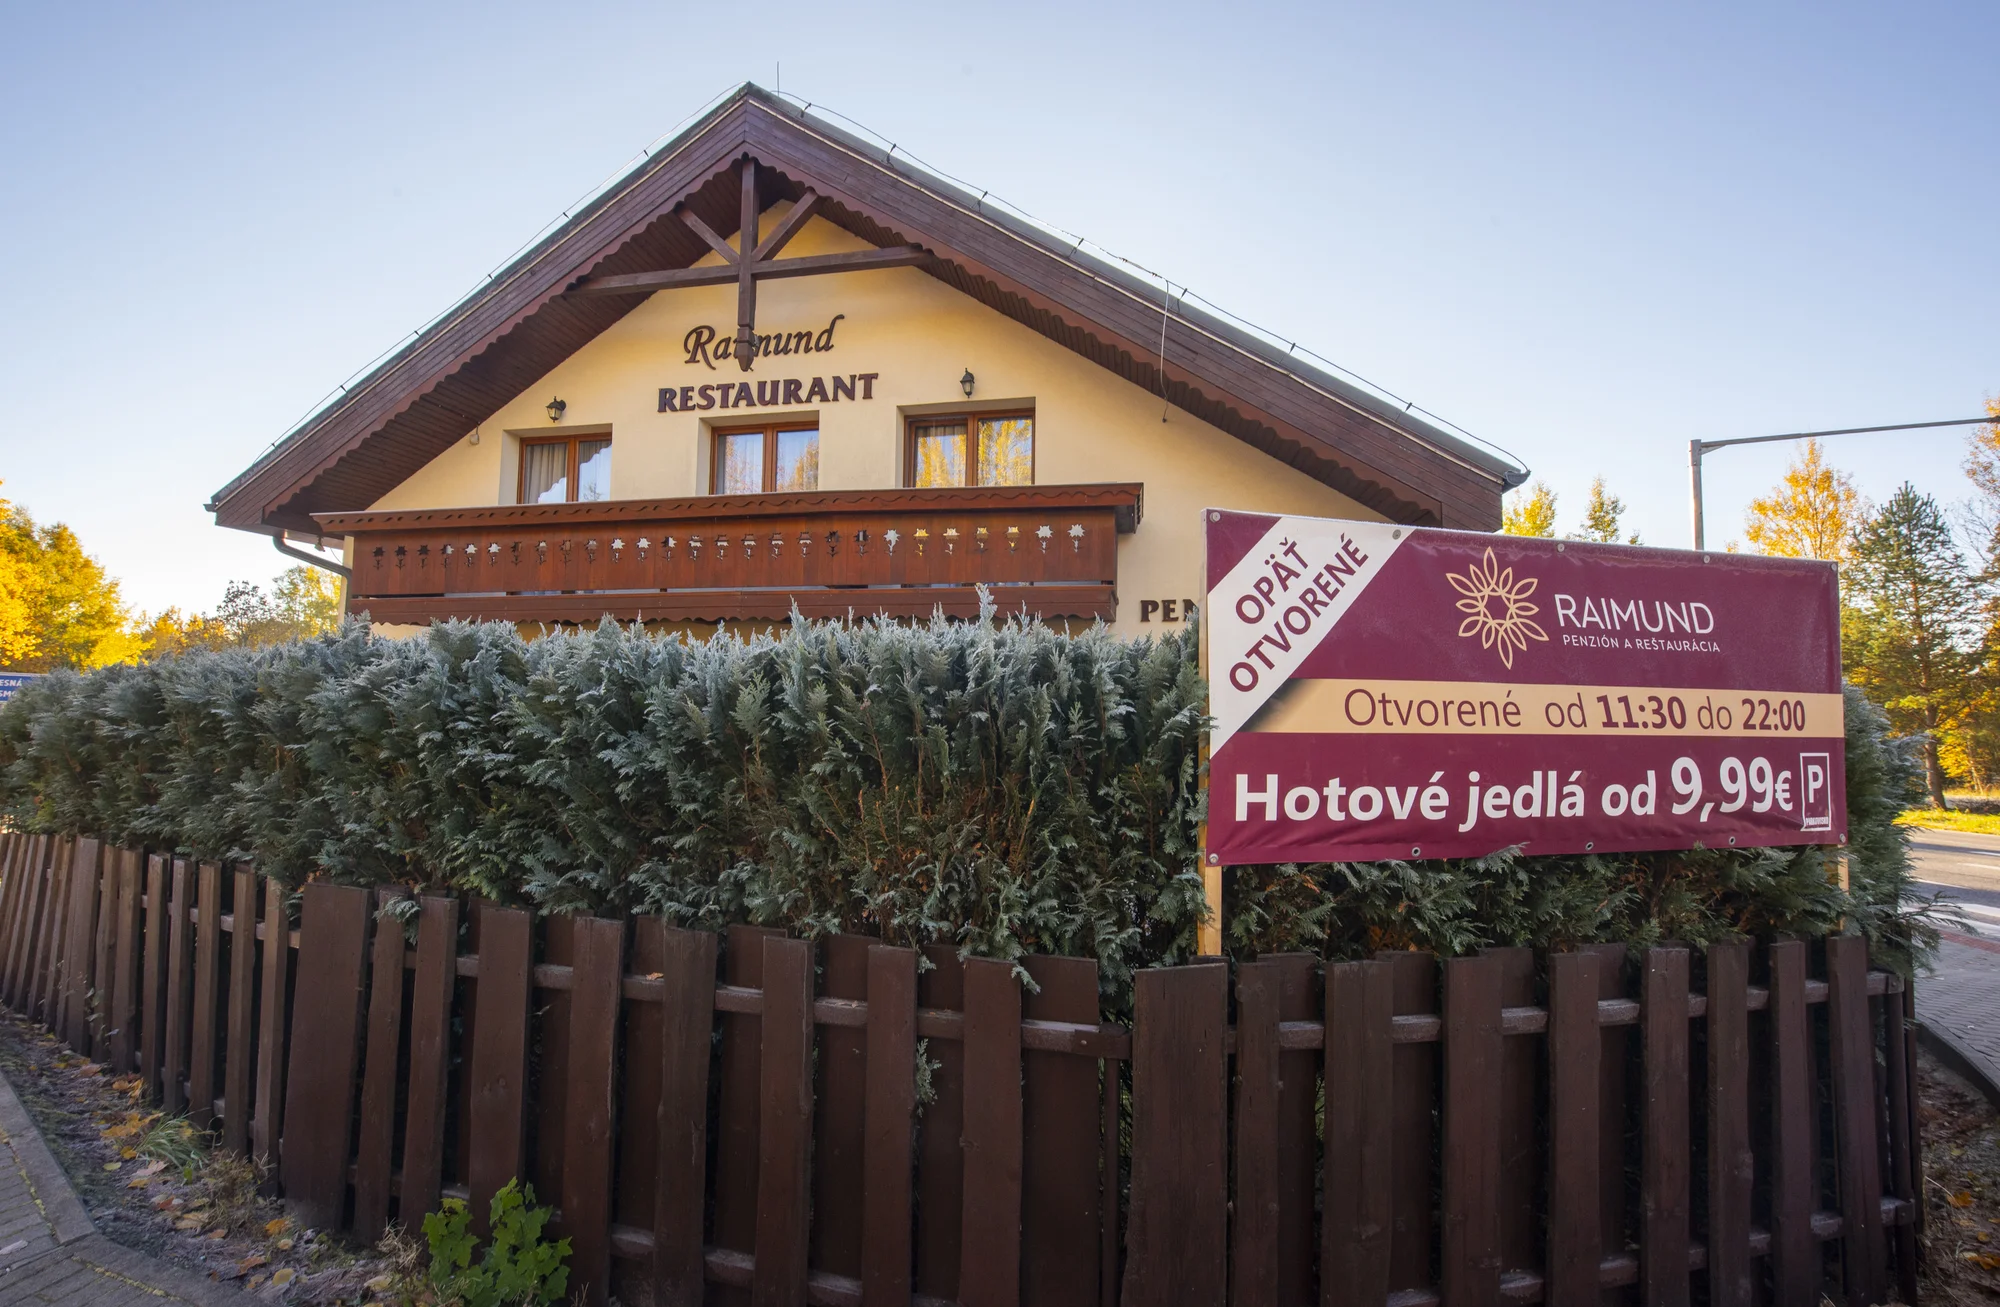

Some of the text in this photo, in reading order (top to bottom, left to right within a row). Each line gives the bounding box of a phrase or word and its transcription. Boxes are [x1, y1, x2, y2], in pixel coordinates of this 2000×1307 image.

[657, 372, 879, 413] RESTAURANT
[1235, 536, 1308, 625] OPÄŤ
[1229, 532, 1369, 692] OTVORENÉ
[1554, 593, 1715, 634] RAIMUND
[1562, 634, 1721, 652] PENZIÓN A REŠTAURÁCIA
[1344, 688, 1806, 731] Otvorené od 11:30 do 22:00
[1235, 756, 1793, 832] Hotové jedlá od 9,99€
[1807, 764, 1824, 803] P
